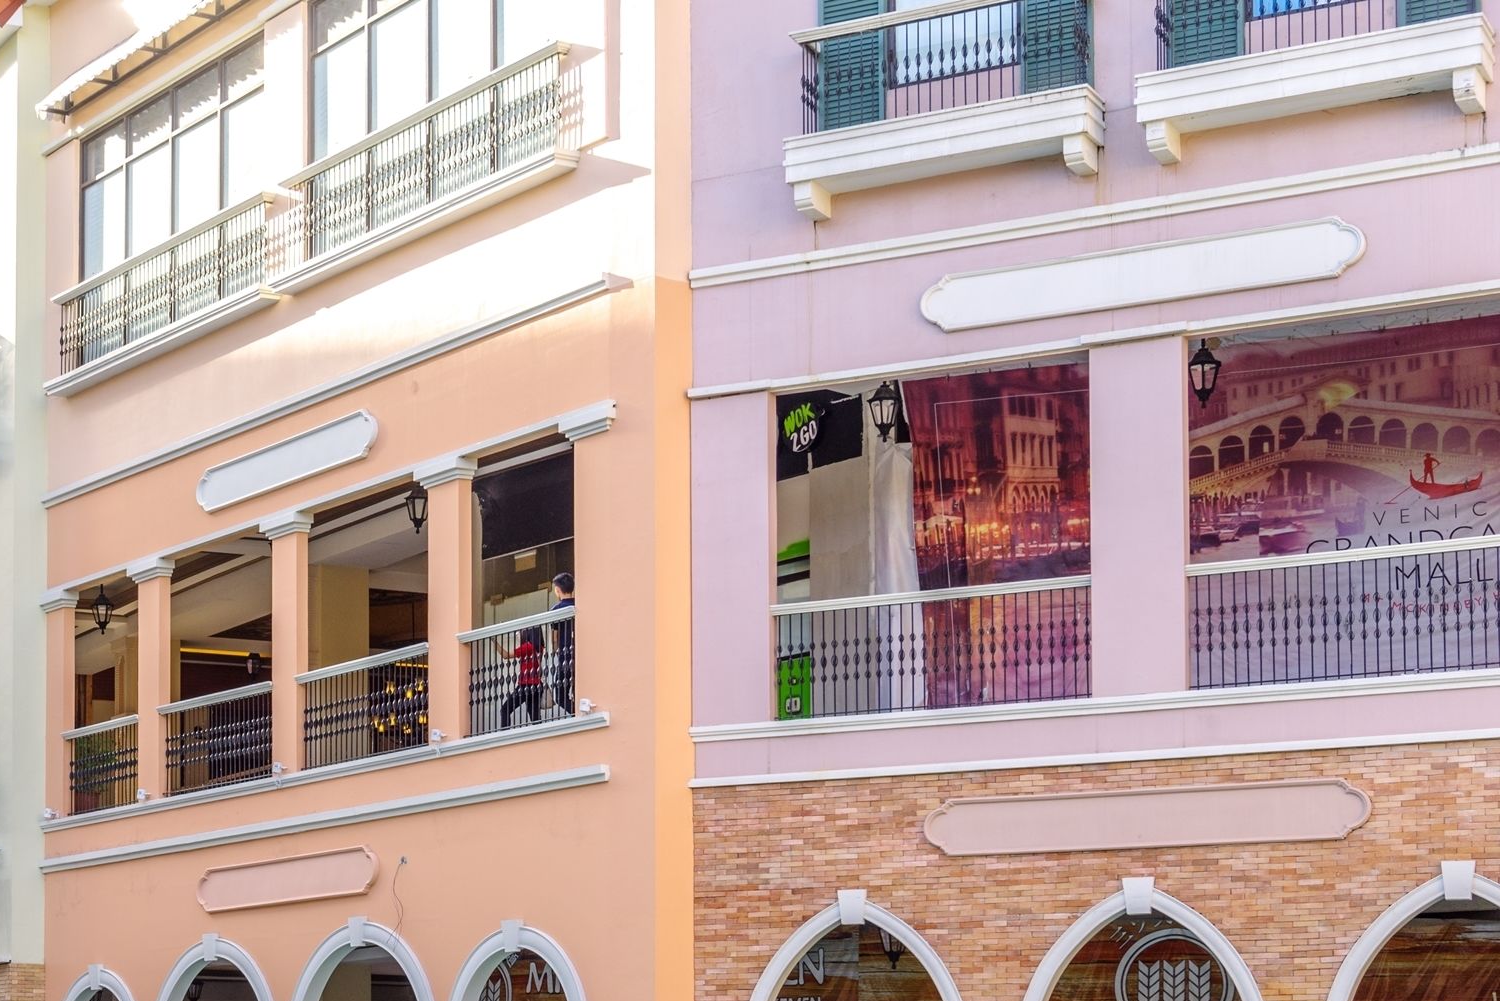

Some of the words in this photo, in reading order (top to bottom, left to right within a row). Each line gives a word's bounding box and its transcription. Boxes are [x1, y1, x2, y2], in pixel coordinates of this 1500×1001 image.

[783, 402, 816, 437] WOK
[790, 420, 818, 452] 2GO
[1394, 558, 1494, 590] MALL
